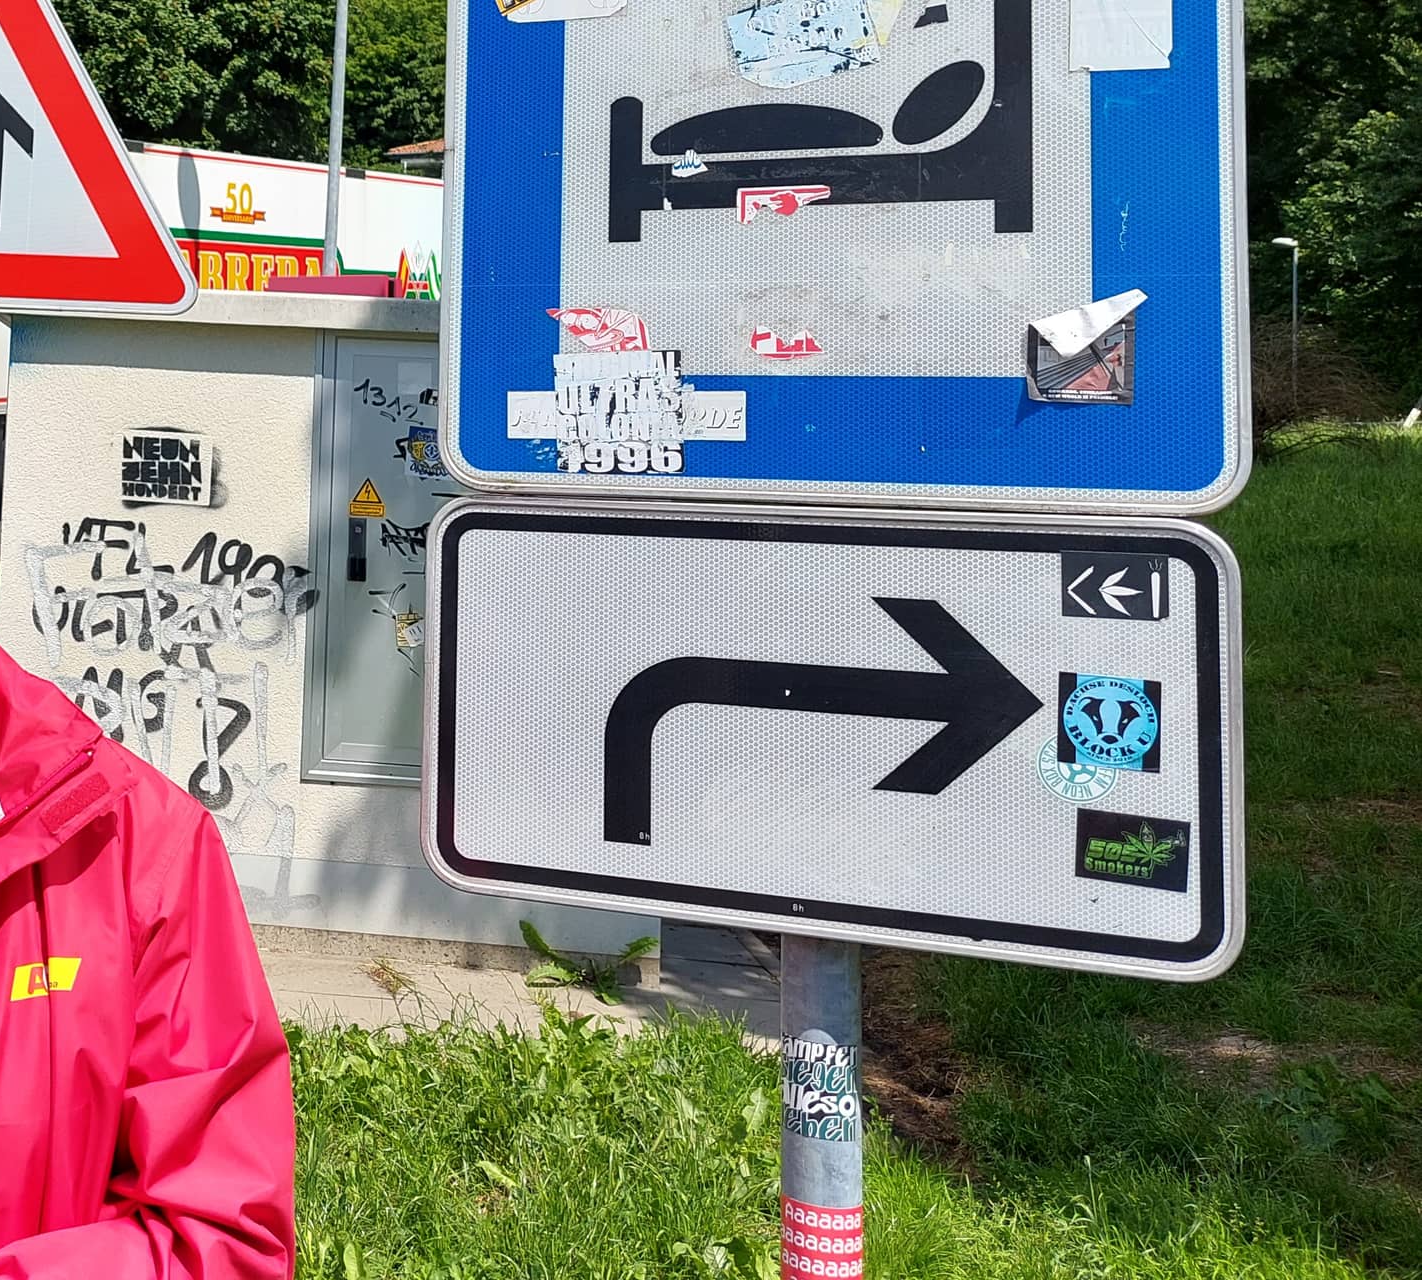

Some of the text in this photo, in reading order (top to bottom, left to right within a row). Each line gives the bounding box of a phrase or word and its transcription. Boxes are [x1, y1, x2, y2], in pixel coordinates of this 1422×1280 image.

[226, 183, 253, 213] 50
[354, 378, 423, 425] 1312
[123, 436, 200, 461] NEUN
[122, 461, 202, 485] ZEHN
[122, 482, 202, 501] HUNDERT
[1066, 681, 1105, 716] DACHSE
[1068, 726, 1137, 758] BLOCK
[1085, 857, 1150, 878] Smokers
